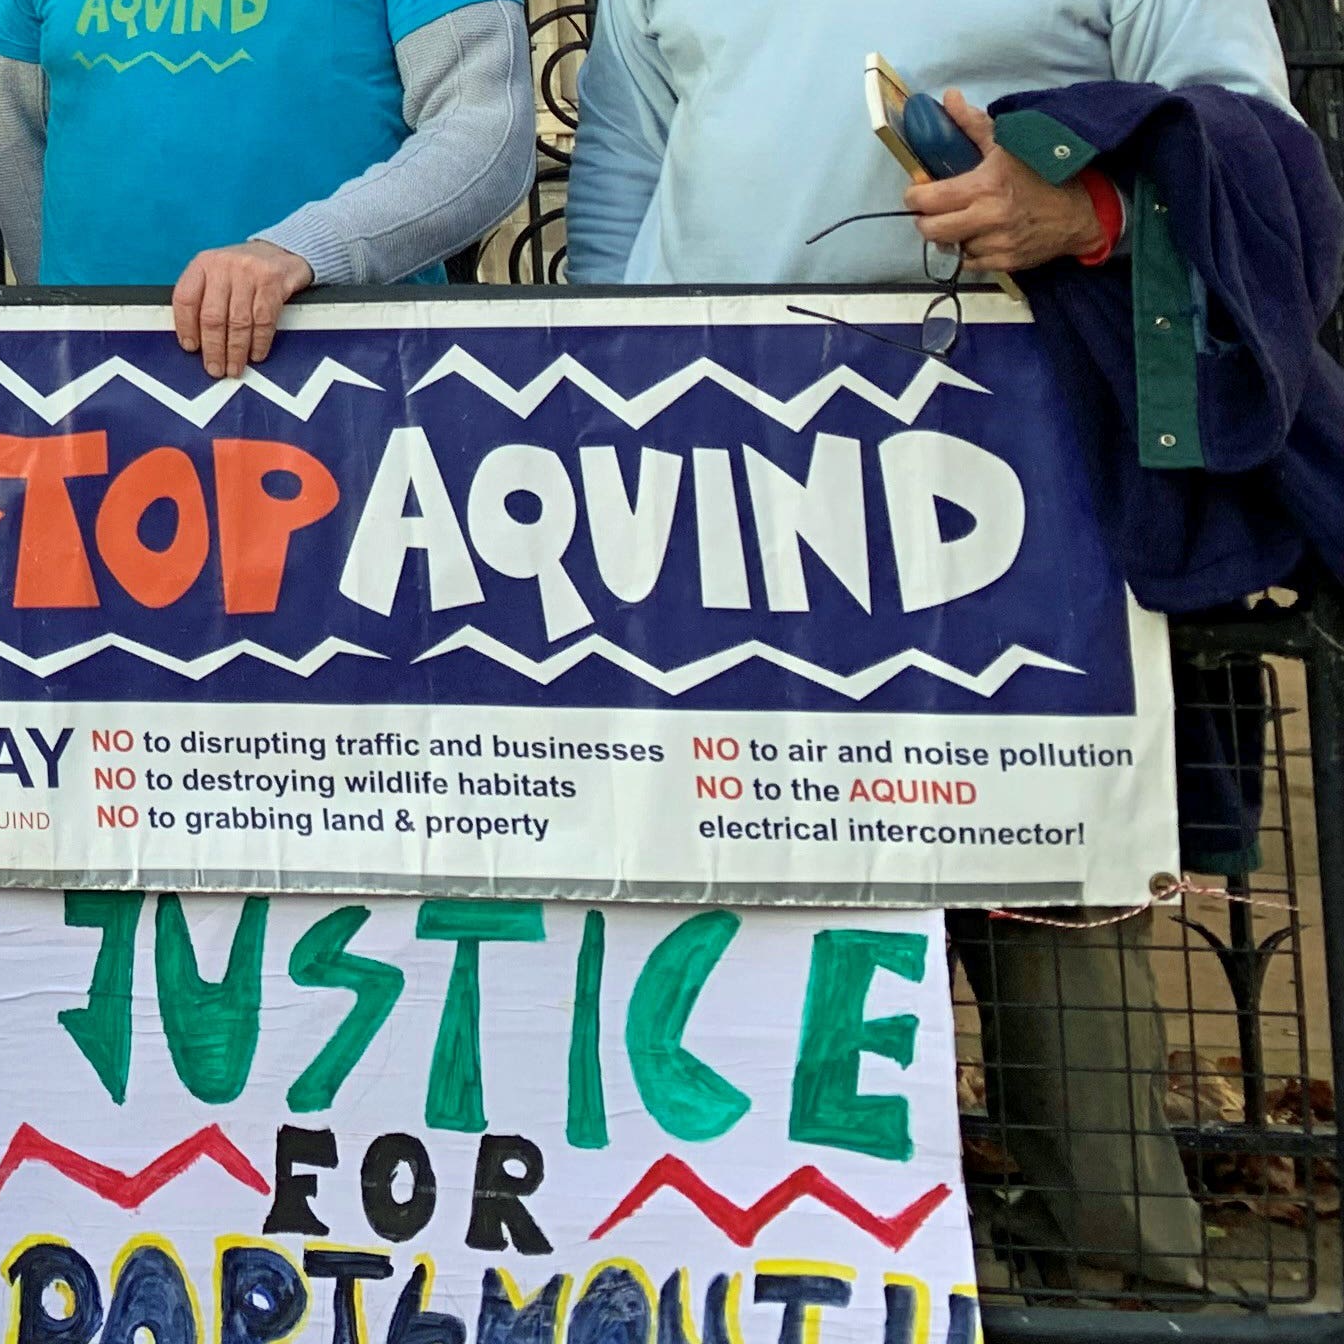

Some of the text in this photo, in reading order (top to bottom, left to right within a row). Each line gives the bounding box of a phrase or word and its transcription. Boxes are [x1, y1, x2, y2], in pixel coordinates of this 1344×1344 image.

[339, 426, 1025, 642] AQUIND
[91, 729, 665, 762] NO to disrupting traffic and businesses
[692, 737, 1134, 772] NO to air and noise pollution
[94, 767, 577, 799] NO to destroying wildlife habitats
[695, 775, 977, 806] NO to the AQUIND
[97, 805, 550, 842] NO to grabbing land & property
[699, 816, 1085, 846] electrical interconnector!
[56, 891, 928, 1162] JUSTICE
[262, 1124, 553, 1254] FOR
